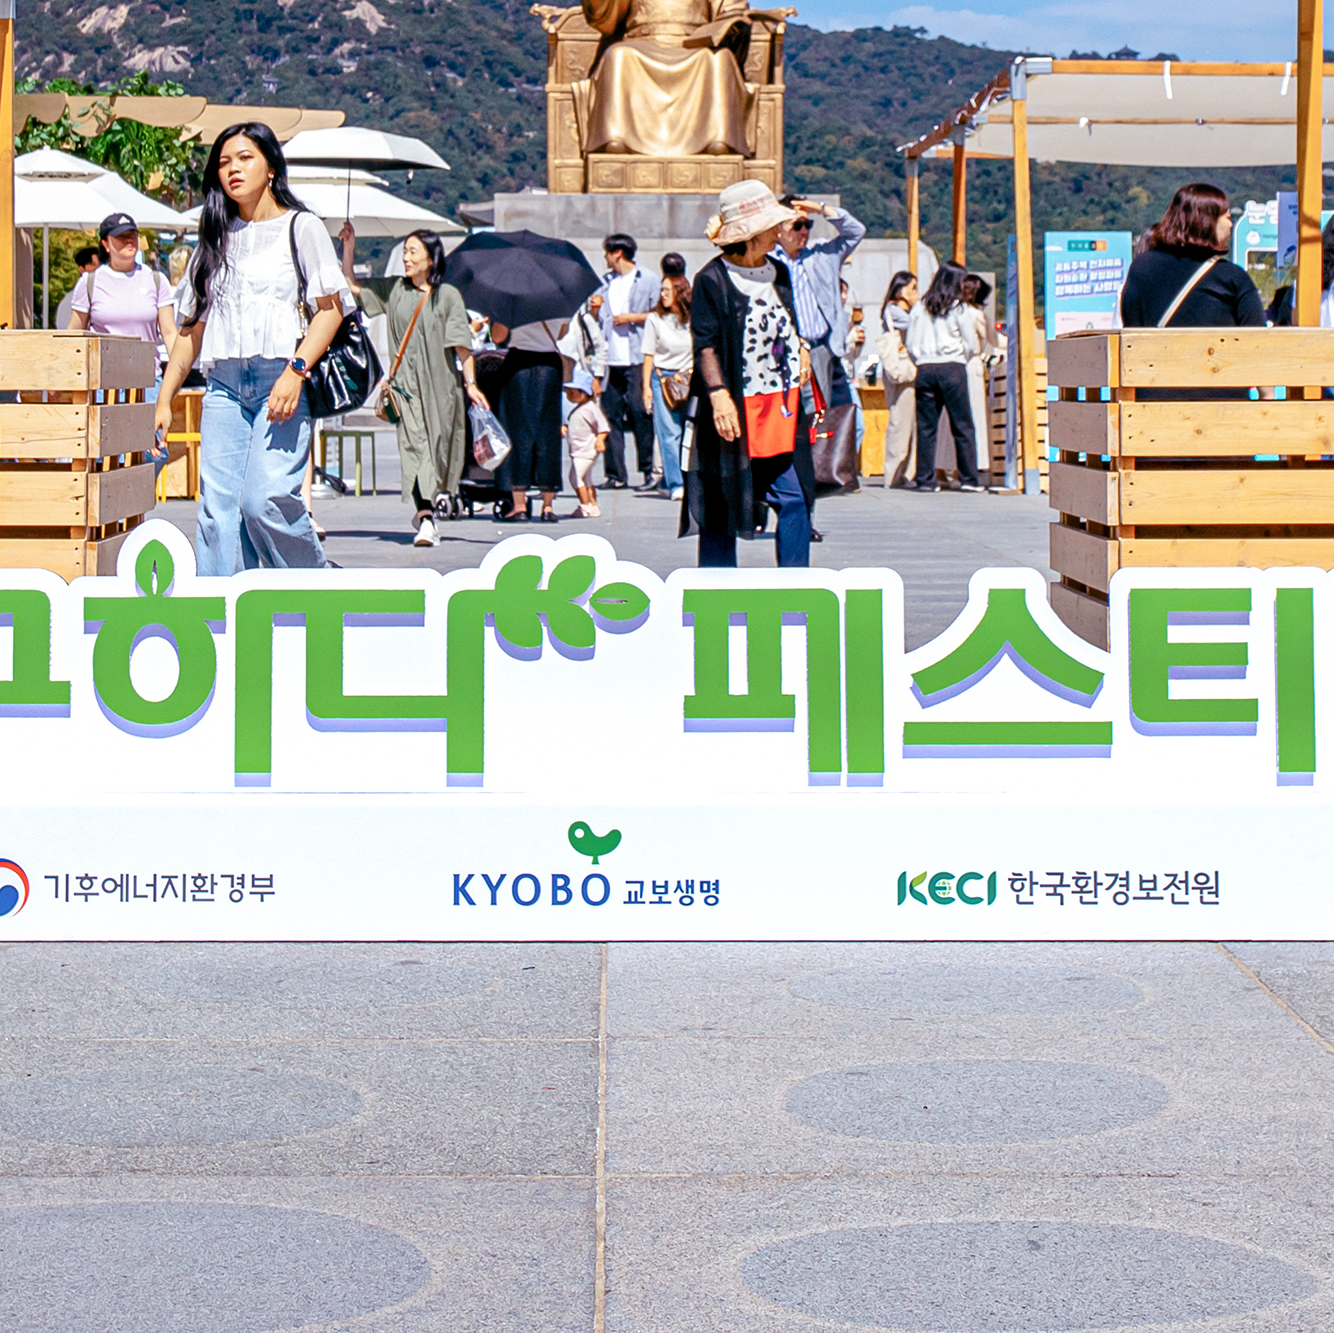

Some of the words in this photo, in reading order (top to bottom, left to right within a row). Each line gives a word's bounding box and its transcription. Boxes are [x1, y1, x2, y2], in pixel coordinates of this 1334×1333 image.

[43, 872, 276, 904] 기후에너지환경부
[452, 873, 611, 906] KYOBO
[622, 879, 721, 906] 교보생명
[897, 870, 998, 906] KECI
[1007, 870, 1221, 906] 한국환경보전원
